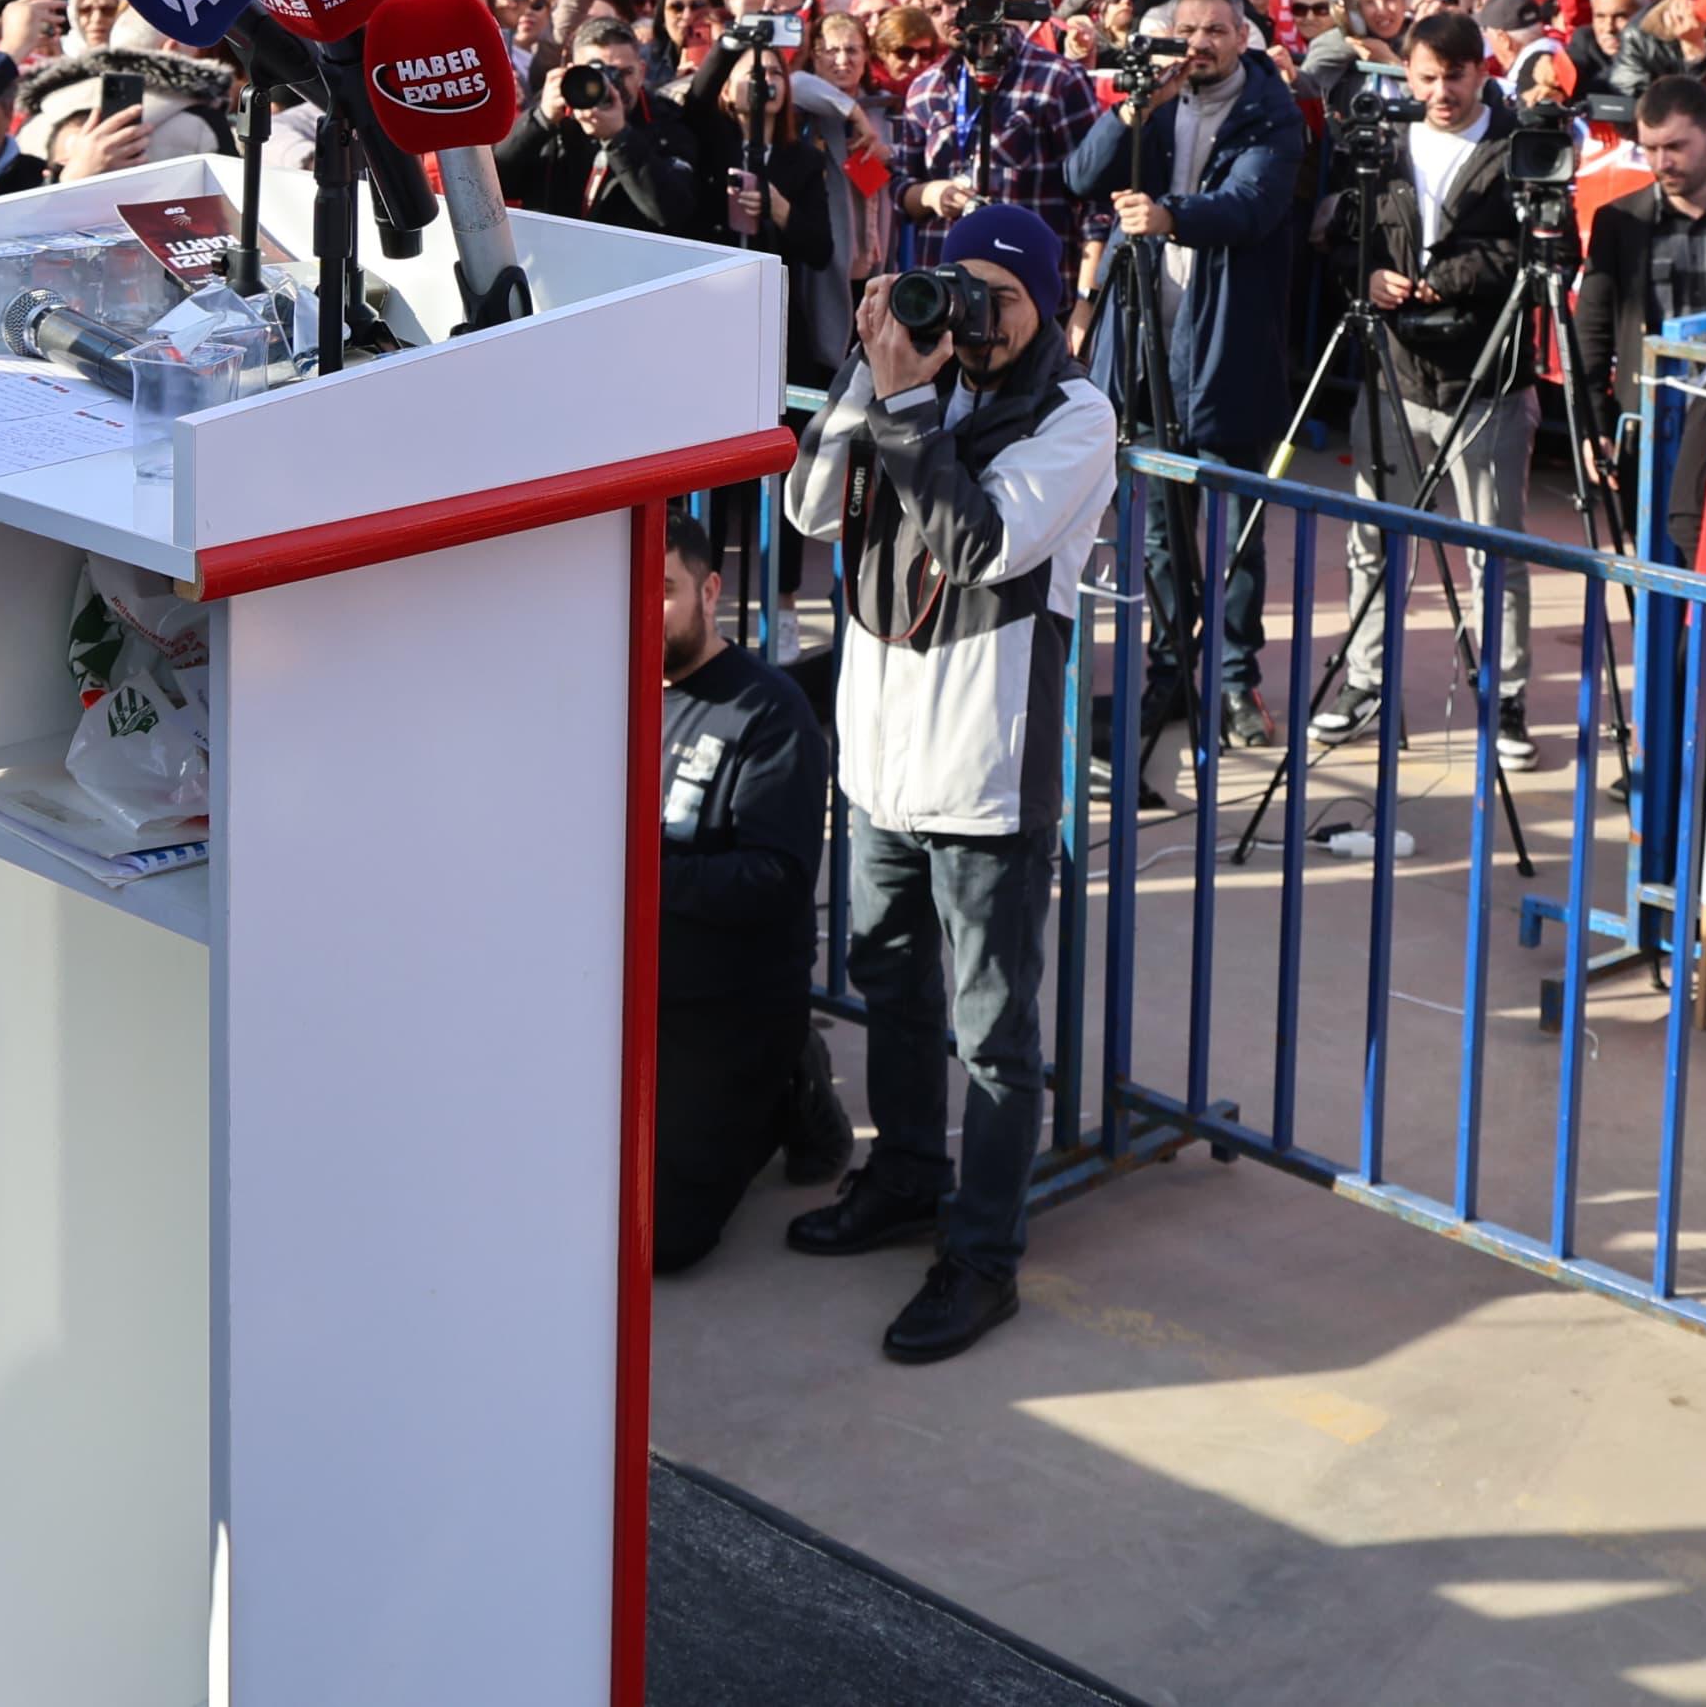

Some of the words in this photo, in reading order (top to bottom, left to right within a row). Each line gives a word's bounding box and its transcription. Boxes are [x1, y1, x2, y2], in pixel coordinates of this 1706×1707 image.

[396, 47, 481, 82] HABER
[403, 73, 487, 104] EXPRES
[848, 466, 866, 518] Canon
